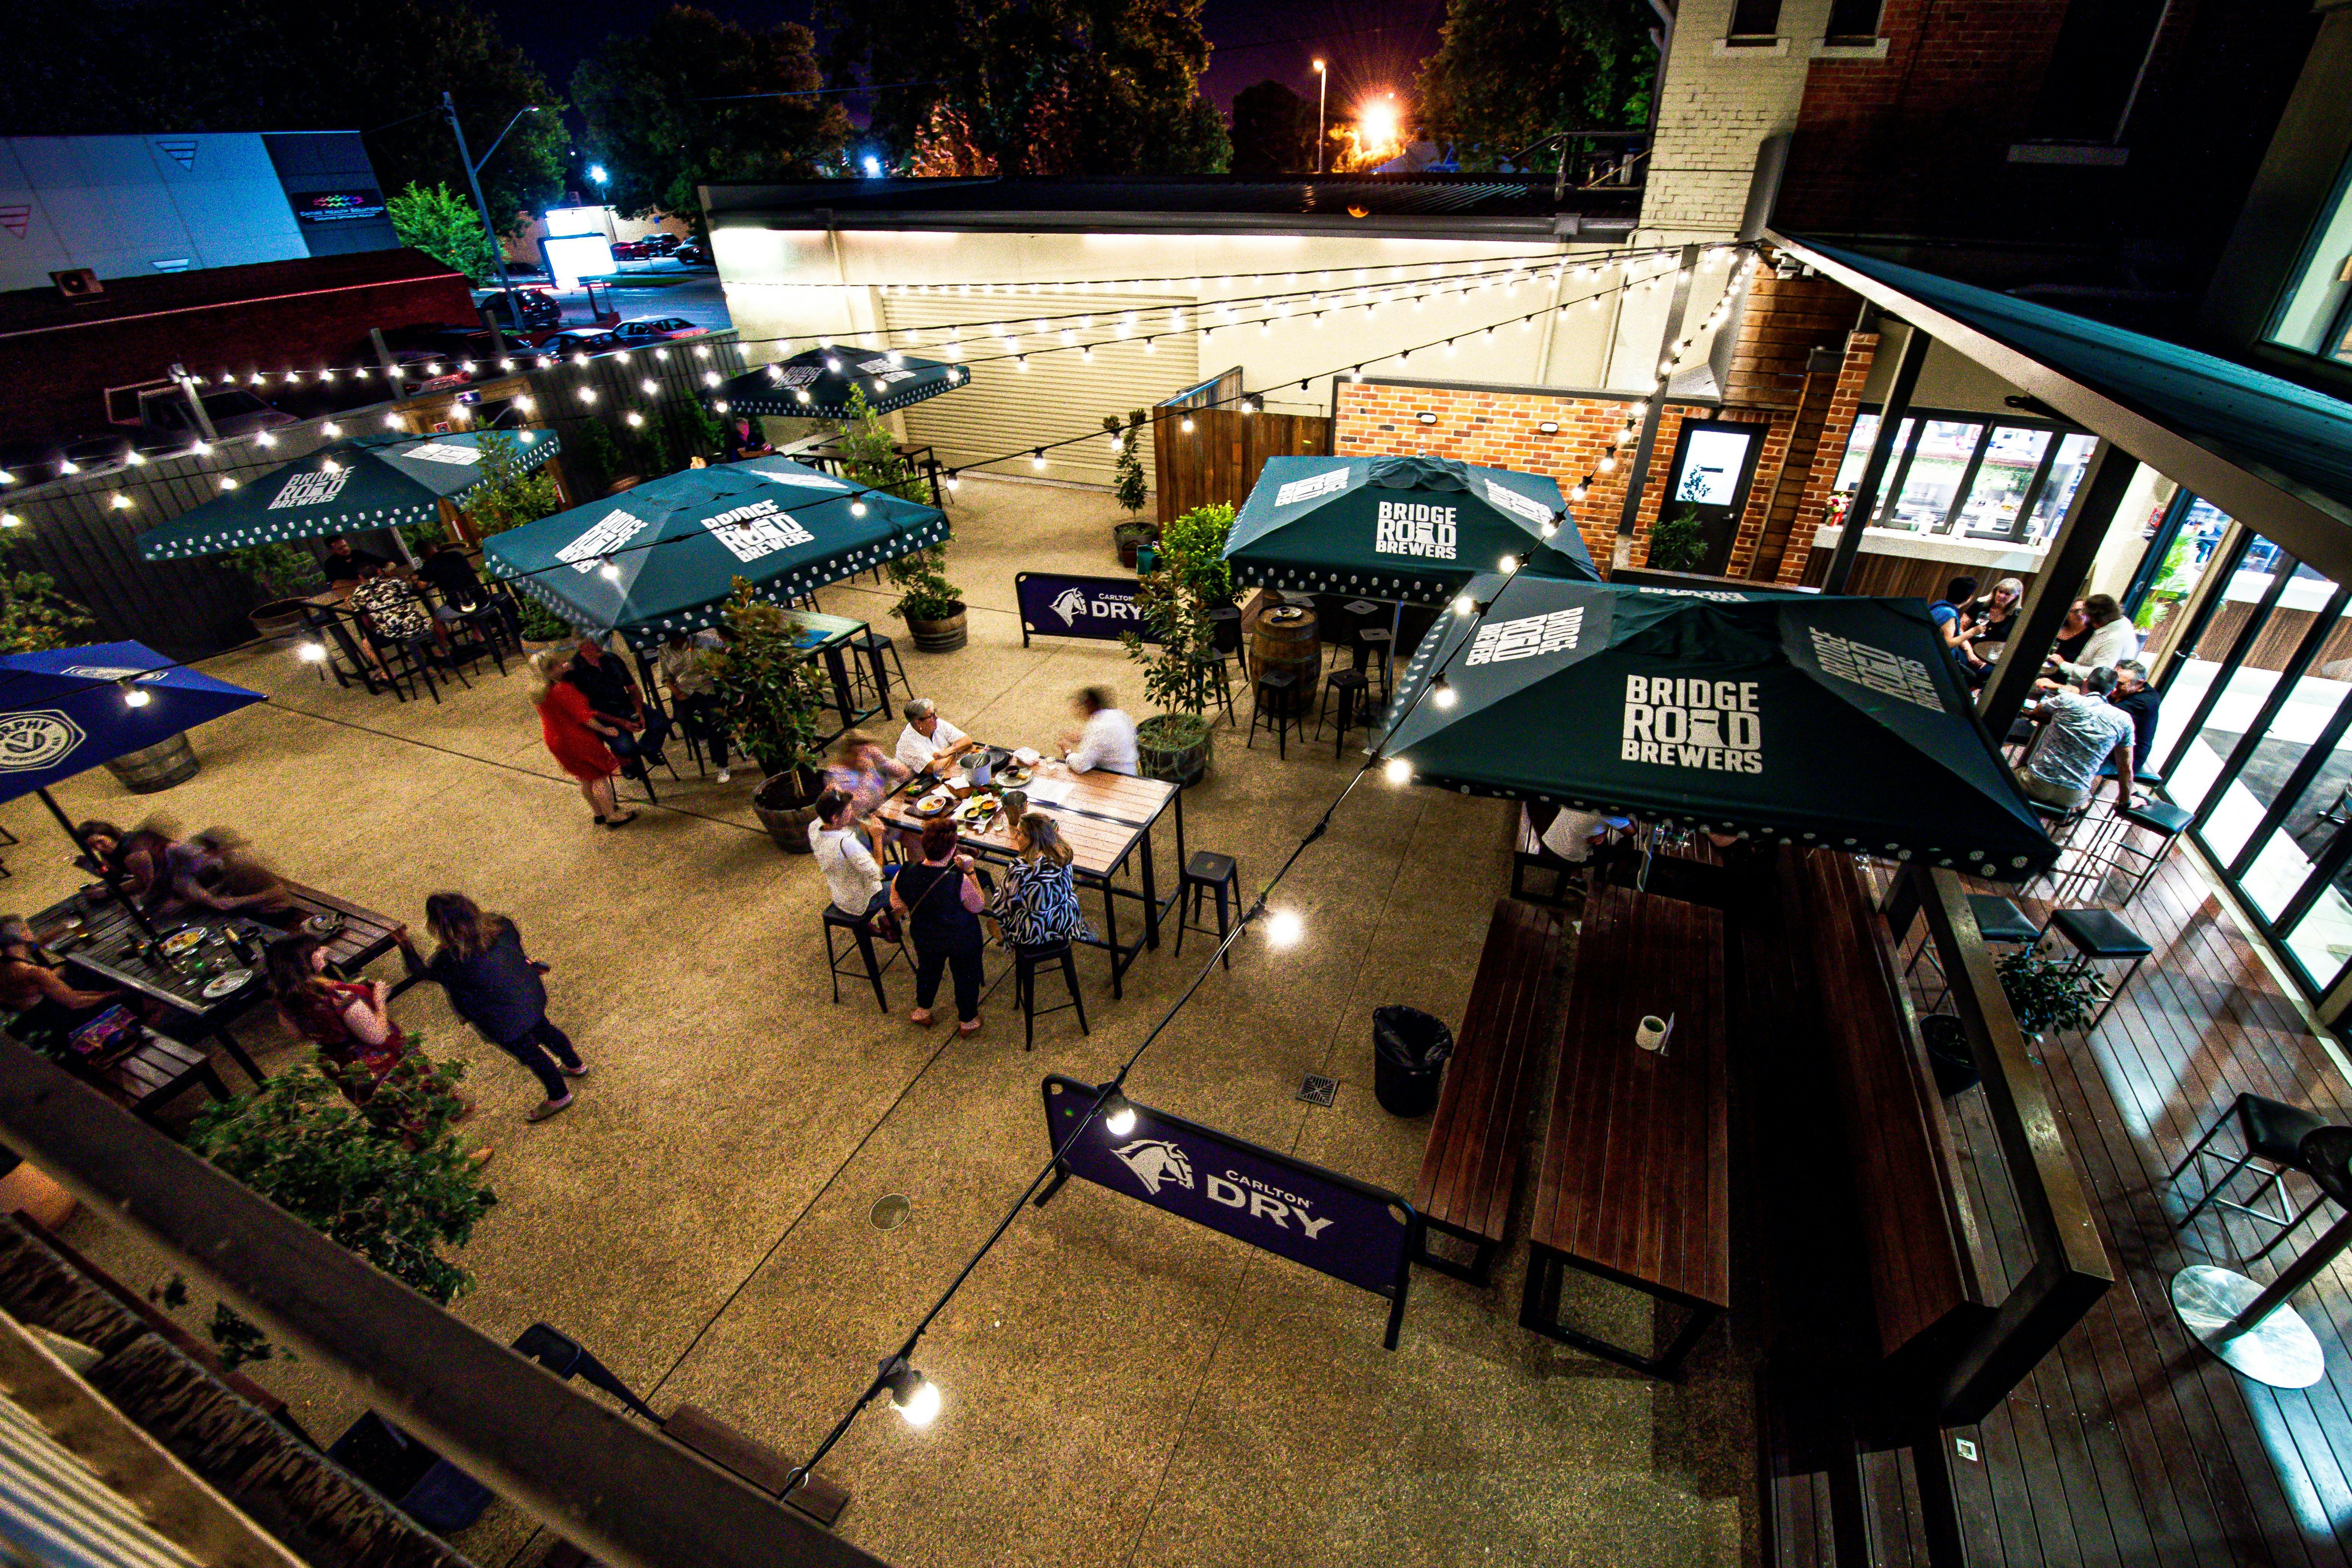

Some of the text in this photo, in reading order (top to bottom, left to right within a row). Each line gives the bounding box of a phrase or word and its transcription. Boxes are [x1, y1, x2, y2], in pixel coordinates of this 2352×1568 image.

[267, 493, 338, 510] BREWERS
[1379, 501, 1456, 525] BRIDGE
[735, 530, 815, 563] BREWERS
[1375, 540, 1456, 559] BREWERS
[1377, 518, 1456, 546] ROAD
[1091, 601, 1144, 620] DRY
[1465, 622, 1505, 666] BREWERS
[1492, 614, 1548, 662] ROAD
[1537, 606, 1584, 655] BRIDGE
[1809, 626, 1864, 685] BRIDGE
[1626, 674, 1760, 712] BRIDGE
[1623, 702, 1762, 751] ROAD
[1621, 739, 1763, 774] BREWERS
[1207, 1174, 1335, 1240] DRY
[1226, 1170, 1310, 1209] CARLTON
